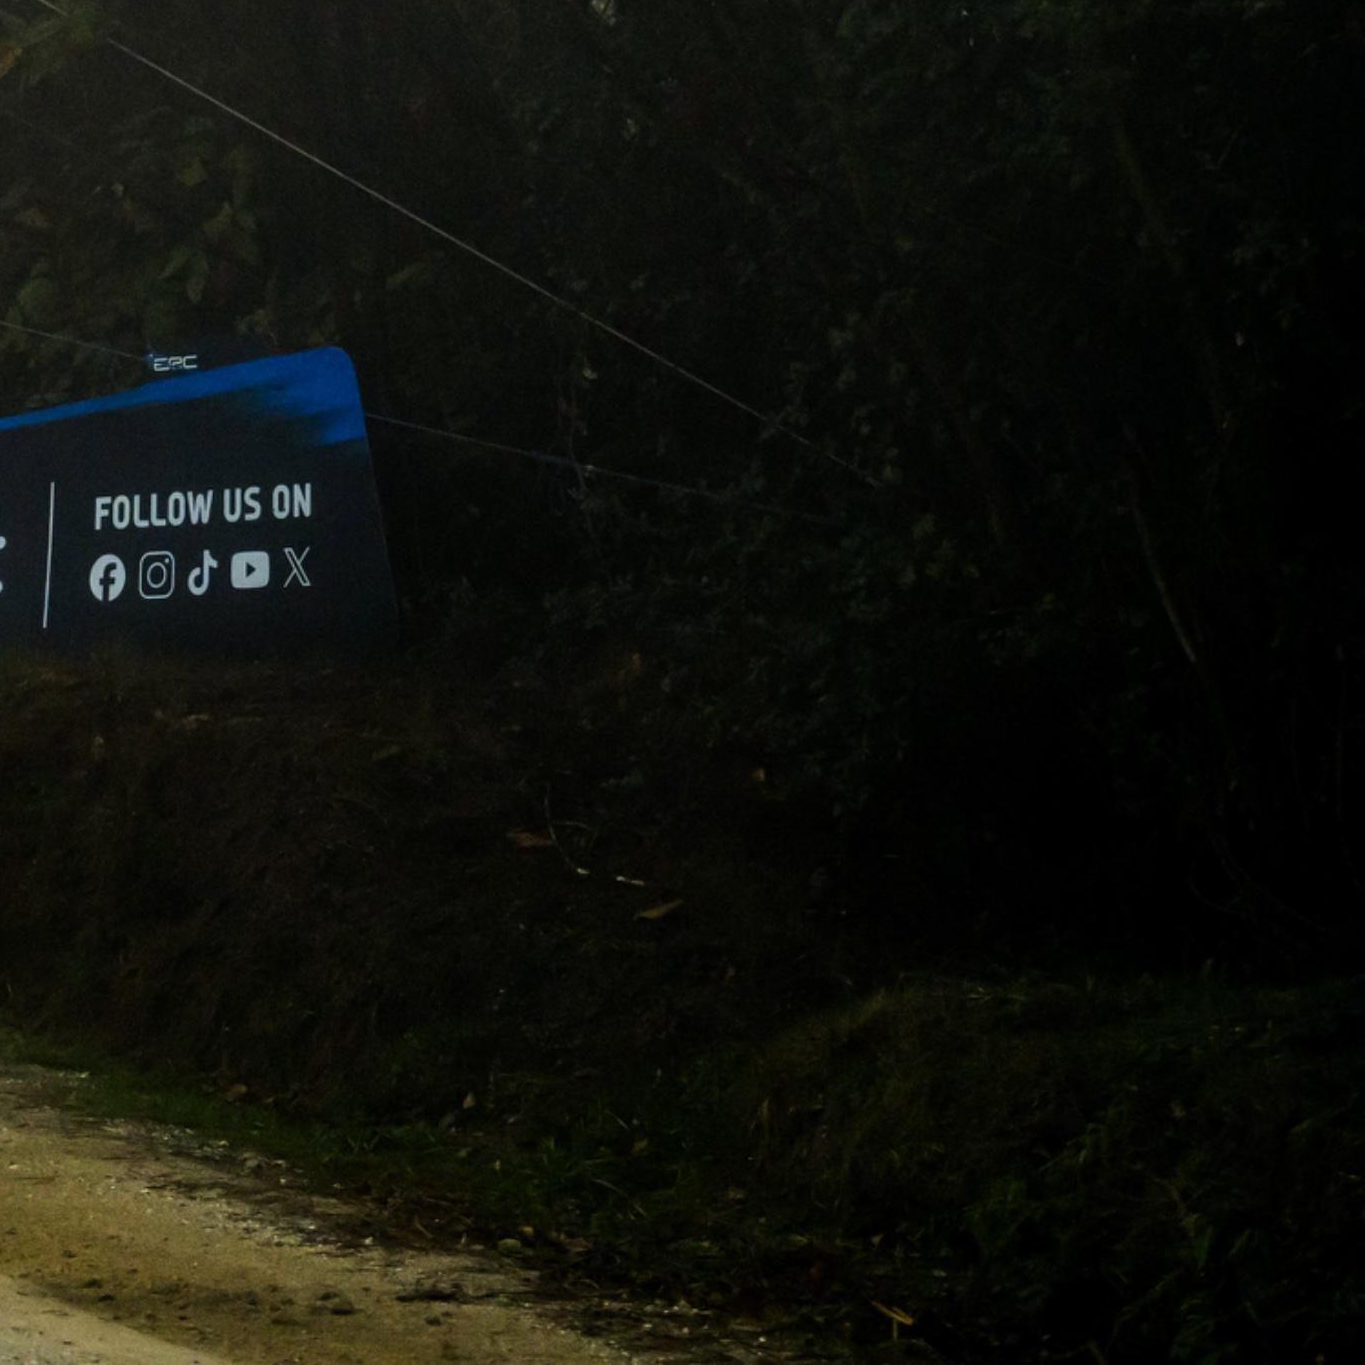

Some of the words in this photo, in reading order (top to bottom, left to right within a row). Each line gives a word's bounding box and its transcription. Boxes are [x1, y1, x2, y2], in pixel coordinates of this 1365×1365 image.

[94, 489, 213, 530] FOLLOW
[223, 486, 262, 523] US
[272, 483, 311, 519] ON
